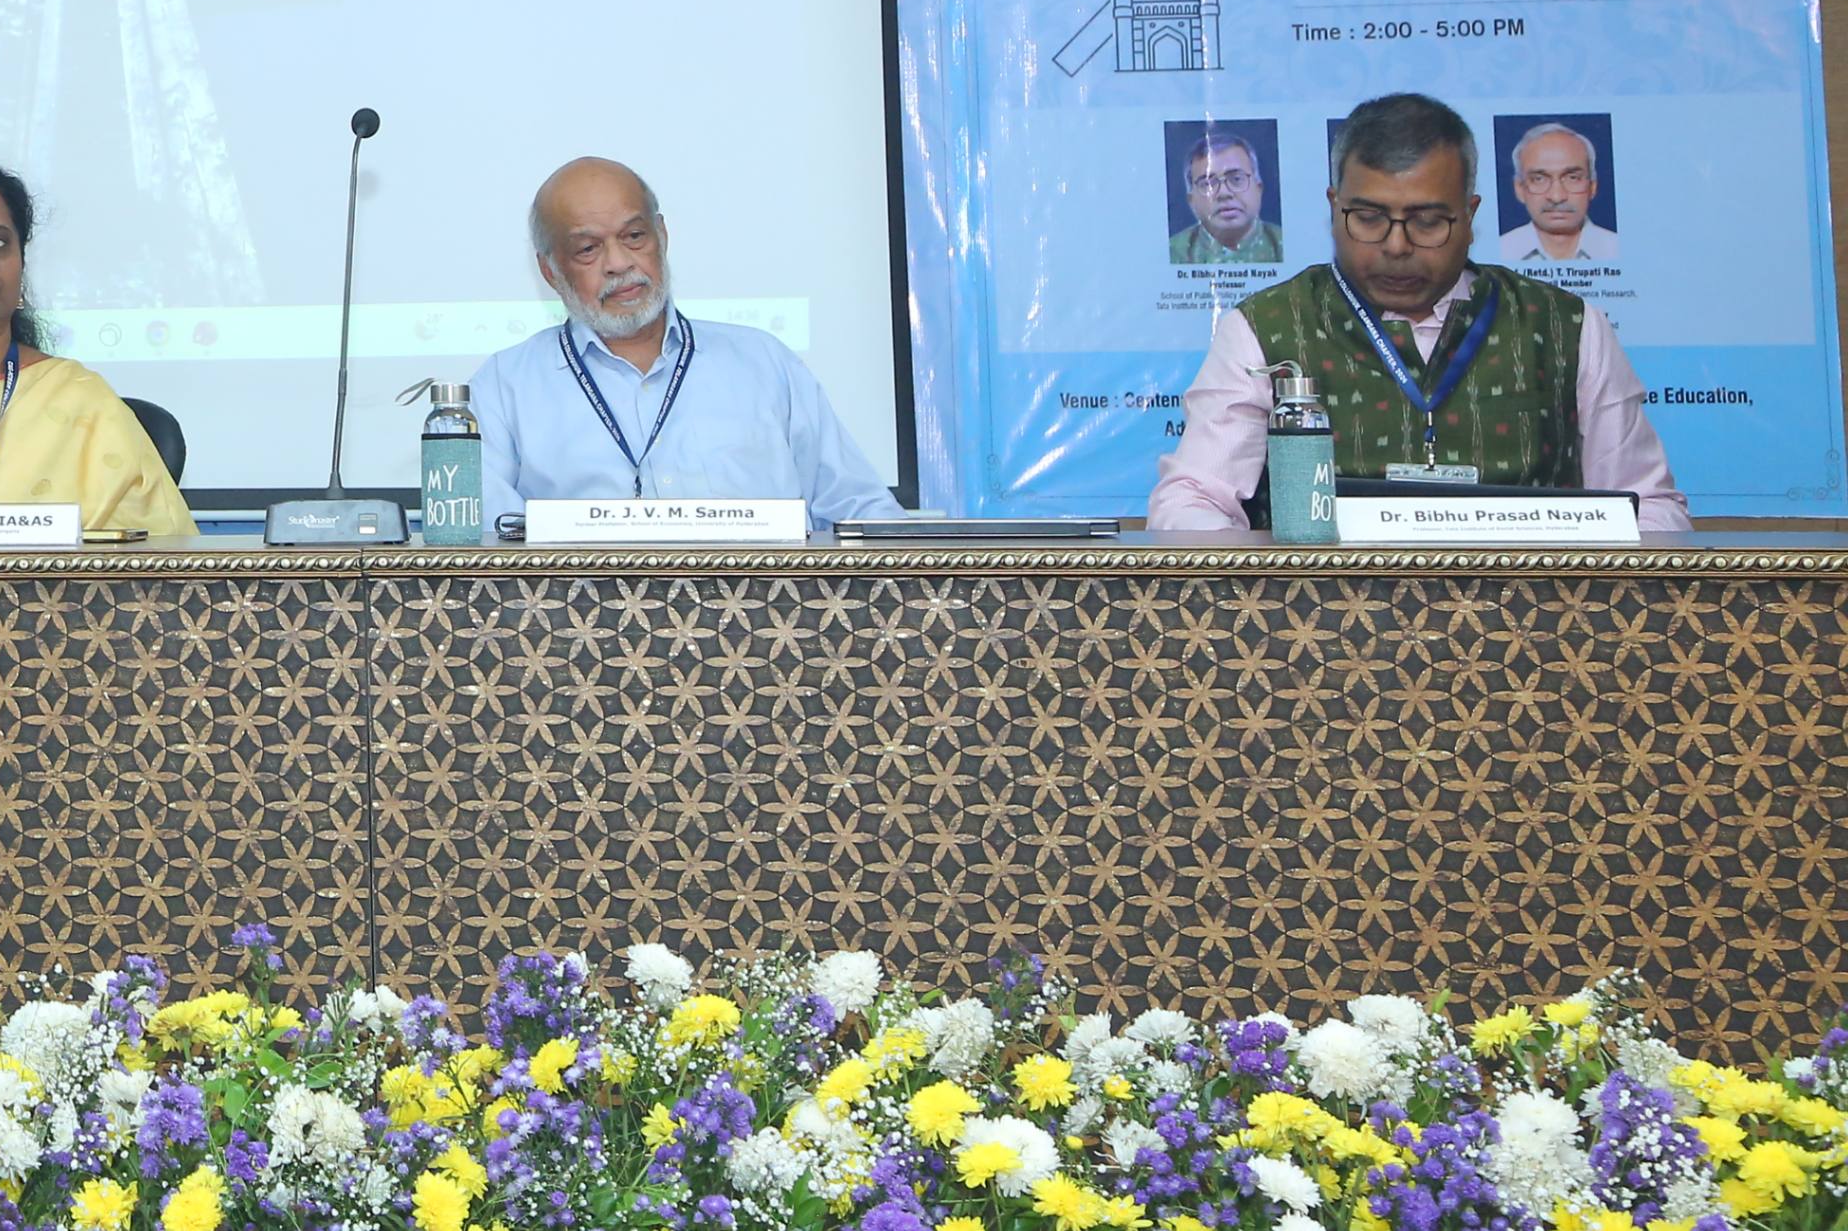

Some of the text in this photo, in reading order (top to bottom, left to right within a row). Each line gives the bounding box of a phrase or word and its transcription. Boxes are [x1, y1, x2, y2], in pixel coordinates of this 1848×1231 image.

[1292, 24, 1341, 40] Time
[1364, 21, 1412, 39] 2:00
[1436, 20, 1485, 37] 5:00
[1494, 18, 1524, 36] PM
[1177, 270, 1188, 279] Dr.
[1218, 270, 1248, 279] Prasad
[1251, 269, 1278, 279] Nayak
[1060, 392, 1108, 409] Venue
[1664, 387, 1753, 406] Education,
[427, 464, 458, 492] MY
[427, 496, 480, 527] BOTTLE
[590, 506, 754, 519] Dr. J. V. M. Sarma
[1380, 509, 1607, 523] Dr. Bibhu Prasad Nayak
